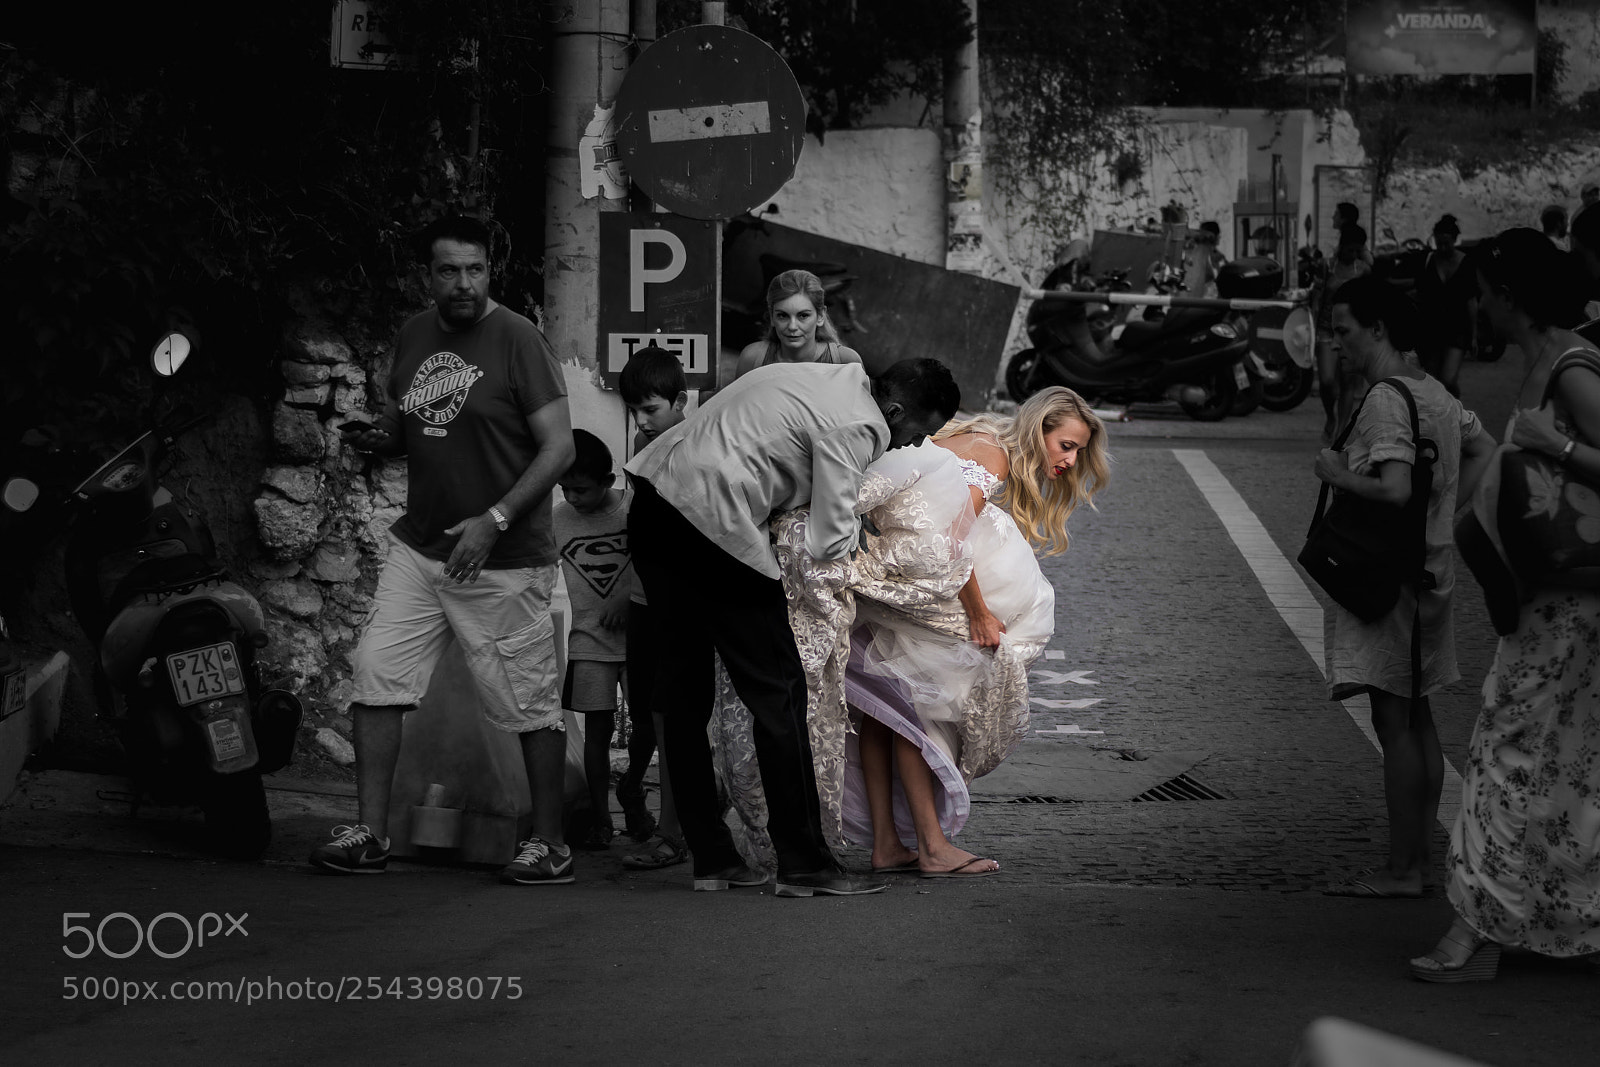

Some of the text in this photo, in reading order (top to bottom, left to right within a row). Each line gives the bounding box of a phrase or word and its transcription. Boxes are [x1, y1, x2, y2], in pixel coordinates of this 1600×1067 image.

[1396, 13, 1485, 29] VERANDA
[630, 229, 687, 312] P
[416, 354, 460, 381] ATHLETIC
[402, 367, 477, 413] TRAINING
[434, 402, 459, 423] BODY
[173, 650, 218, 679] PZK
[182, 672, 224, 700] 143
